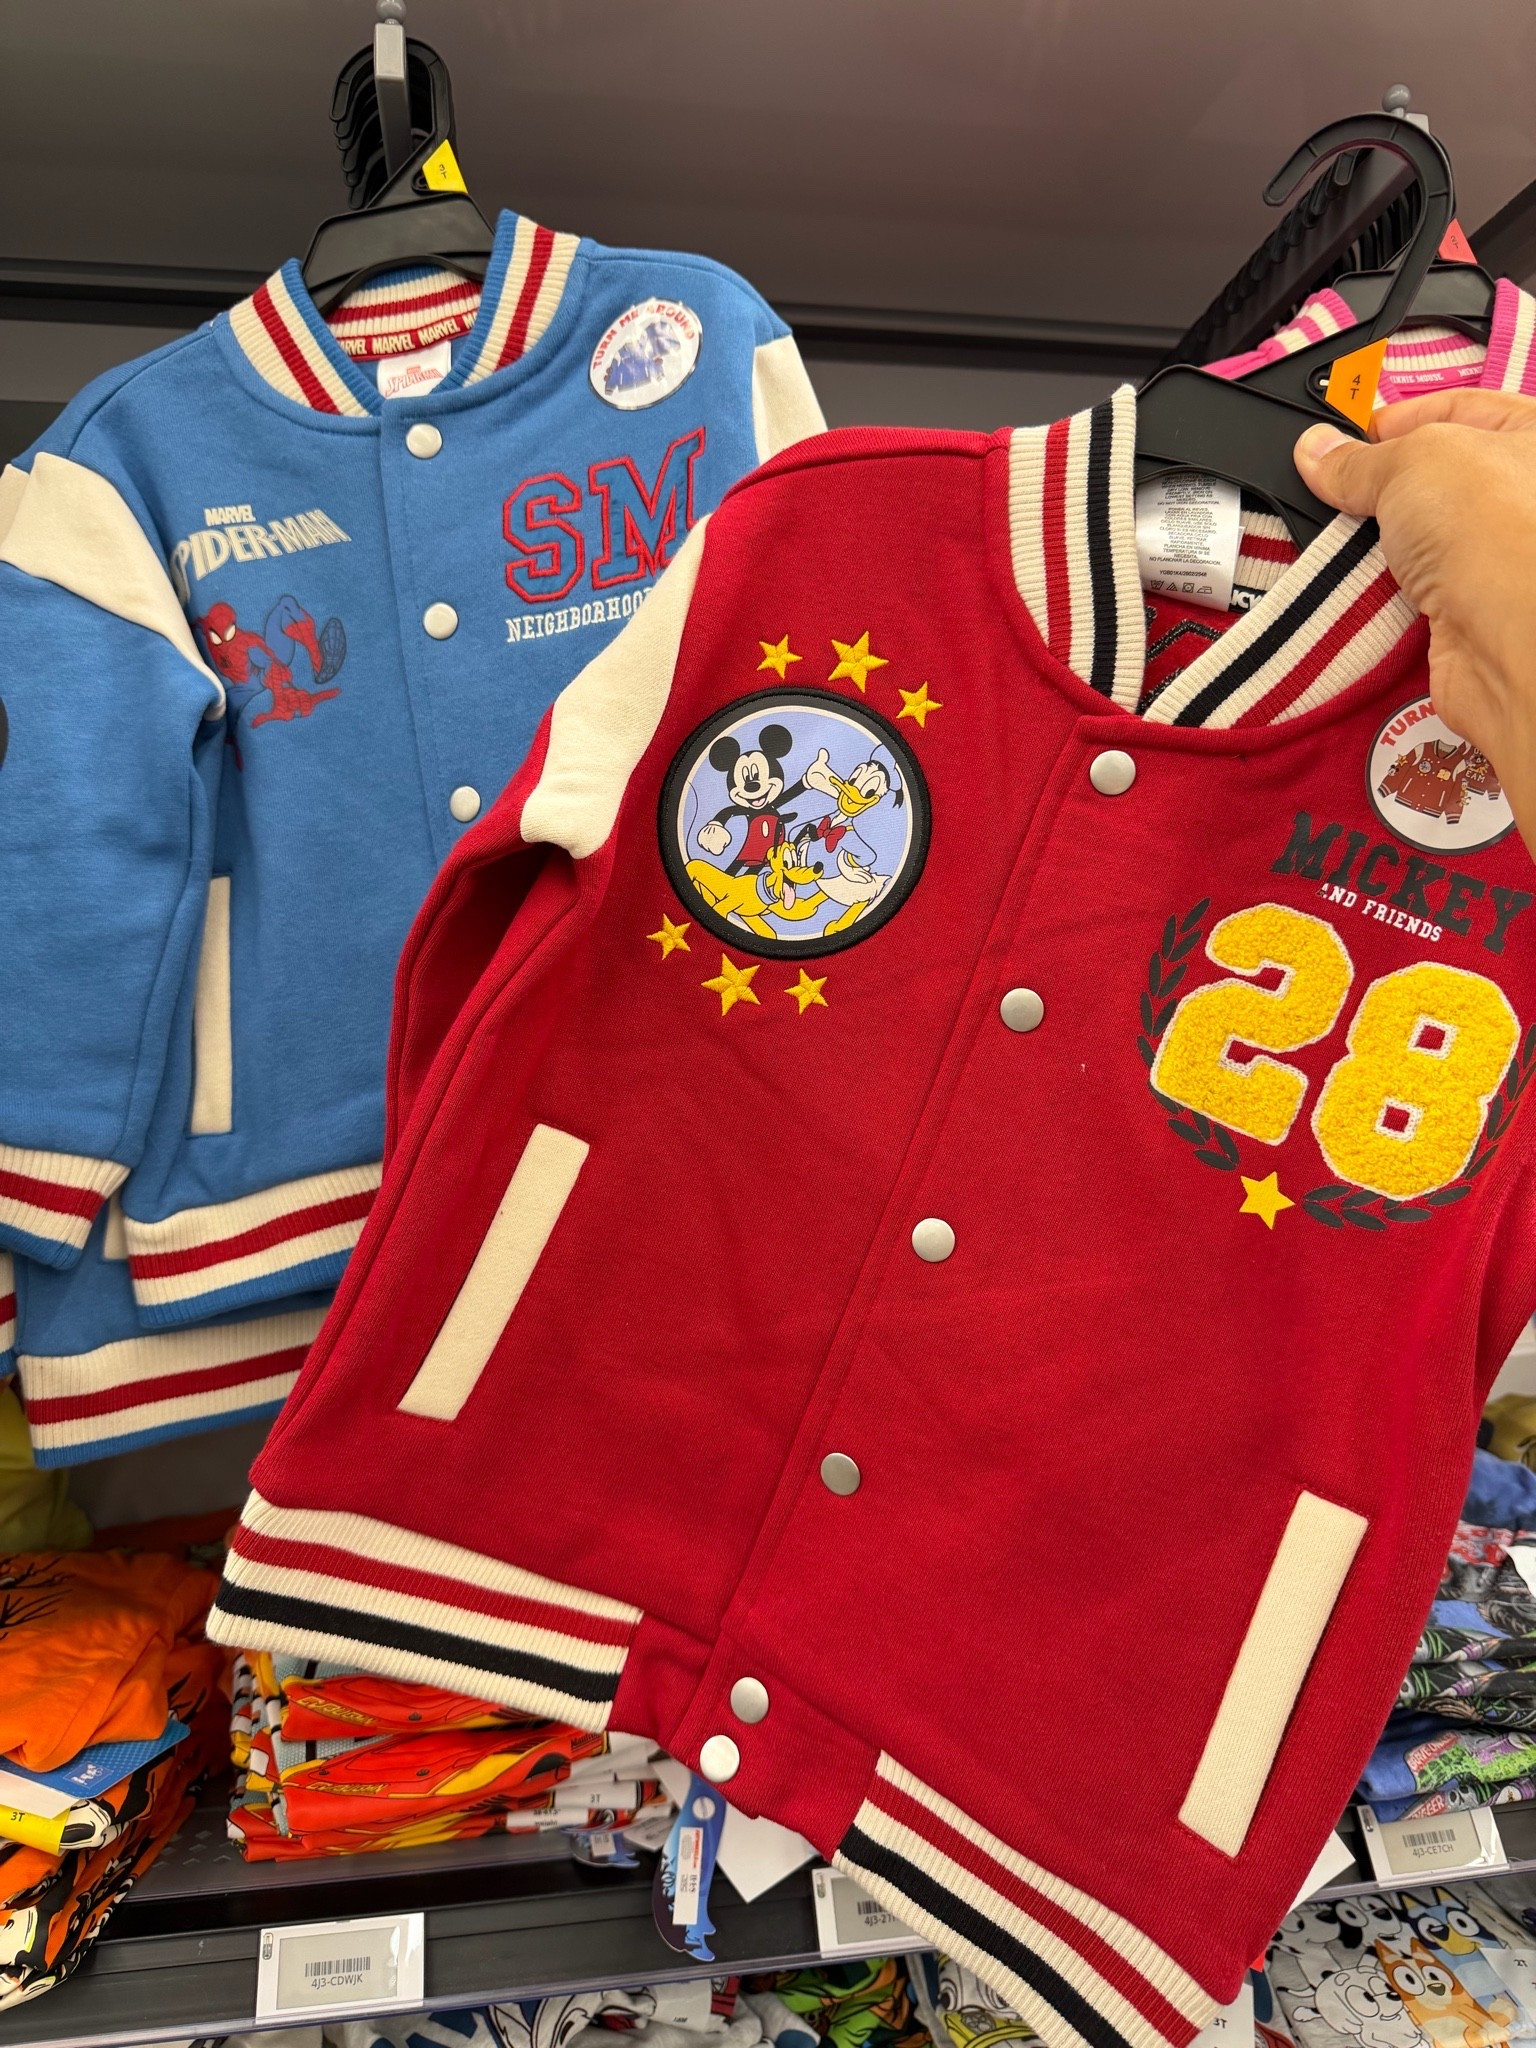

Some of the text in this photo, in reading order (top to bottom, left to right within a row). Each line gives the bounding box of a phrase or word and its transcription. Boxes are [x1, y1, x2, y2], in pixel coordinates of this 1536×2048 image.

[339, 338, 367, 355] ARVEL
[372, 332, 415, 355] MARVEL
[417, 318, 460, 346] MARVEL
[593, 329, 617, 370] TURN
[204, 504, 256, 526] MARVEL
[503, 427, 706, 603] SM
[171, 508, 352, 603] PIDER-MAN
[1380, 702, 1437, 747] TURN
[1465, 770, 1485, 783] EAM
[1269, 810, 1533, 955] MICKEY
[1361, 899, 1443, 942] FRIENDS
[1150, 902, 1521, 1202] 28
[11, 1811, 25, 1822] 3T
[1412, 1844, 1454, 1858] 4J3-CE7CH
[864, 1913, 896, 1927] 4J3-27
[311, 1973, 363, 1990] 4J3-CDWJK
